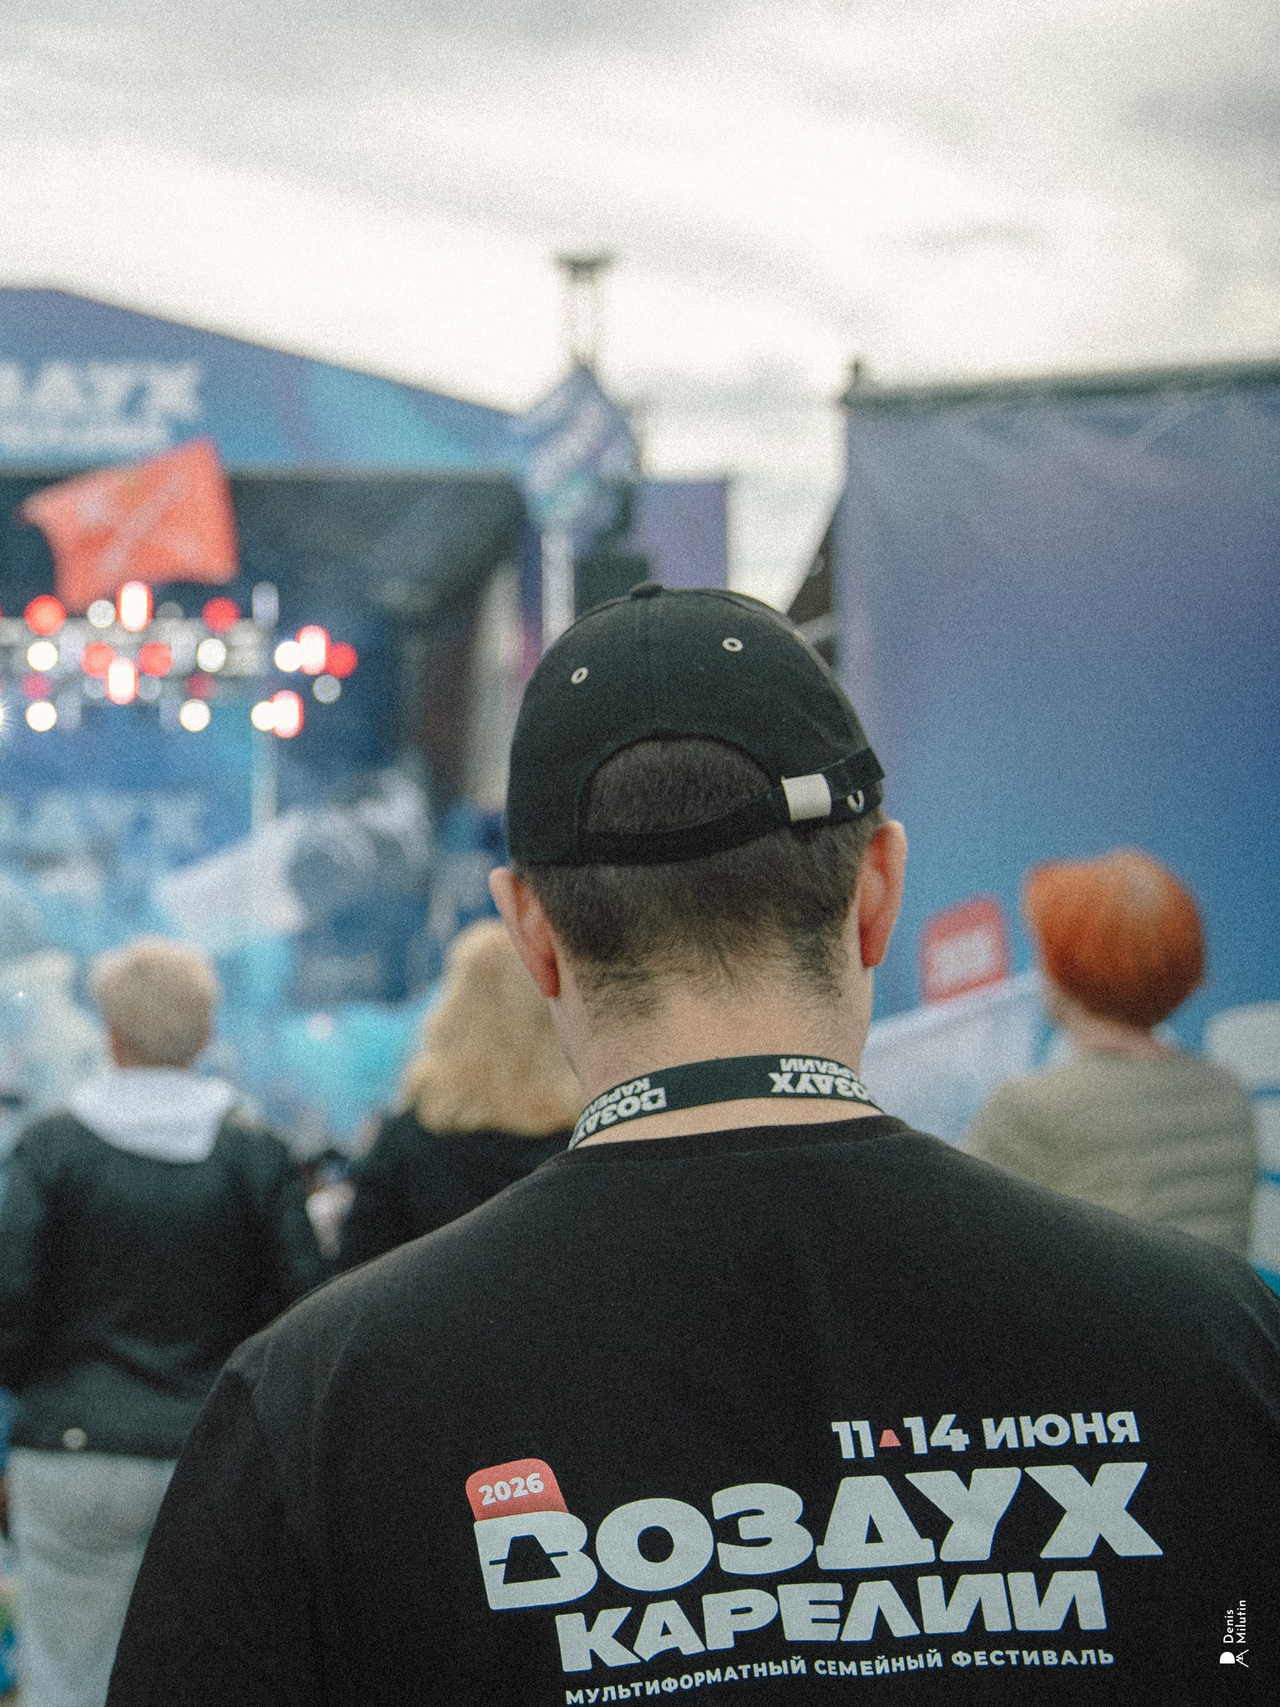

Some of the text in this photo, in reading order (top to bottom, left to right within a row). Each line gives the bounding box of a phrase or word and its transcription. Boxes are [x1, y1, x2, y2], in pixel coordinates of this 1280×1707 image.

[768, 1072, 873, 1102] ОЗДУХ
[982, 1411, 1141, 1450] ИЮНЯ
[478, 1473, 545, 1506] 2026
[473, 1462, 1164, 1611] ВОЗДУХ
[555, 1570, 1108, 1673] КАРЕЛИИ
[565, 1648, 1115, 1706] МУЛЬТИФОРМАТНЫЙ СЕМЕЙНЫЙ ФЕСТИВАЛЬ
